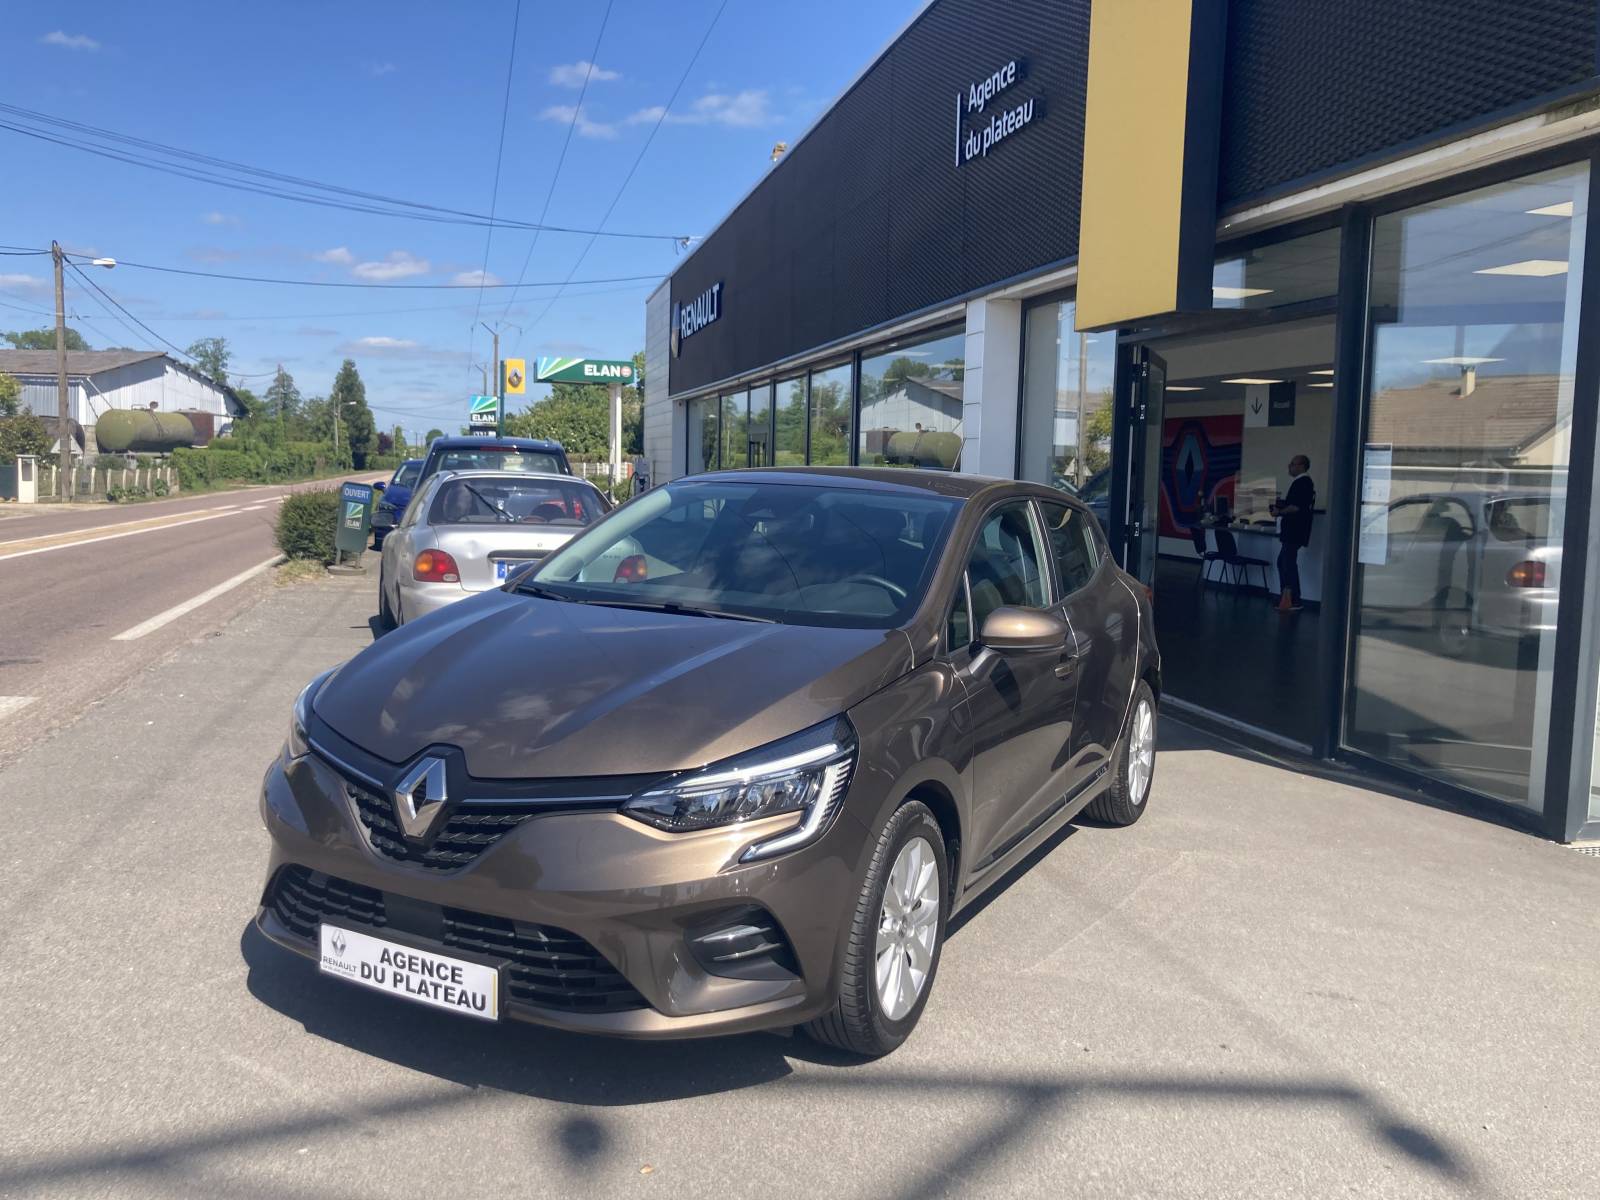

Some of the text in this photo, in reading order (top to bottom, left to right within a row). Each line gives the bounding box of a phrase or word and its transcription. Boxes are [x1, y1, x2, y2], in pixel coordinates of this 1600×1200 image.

[968, 61, 1016, 112] Agence
[966, 99, 1034, 160] du plateau
[681, 283, 720, 339] RENAULT
[584, 364, 621, 377] ELAN
[472, 414, 495, 422] ELAN
[344, 487, 369, 500] OUVERT
[347, 519, 360, 527] ELAN
[323, 955, 357, 973] RENAULT
[380, 948, 463, 985] AGENCE
[360, 961, 487, 1011] DU PLATEAU
